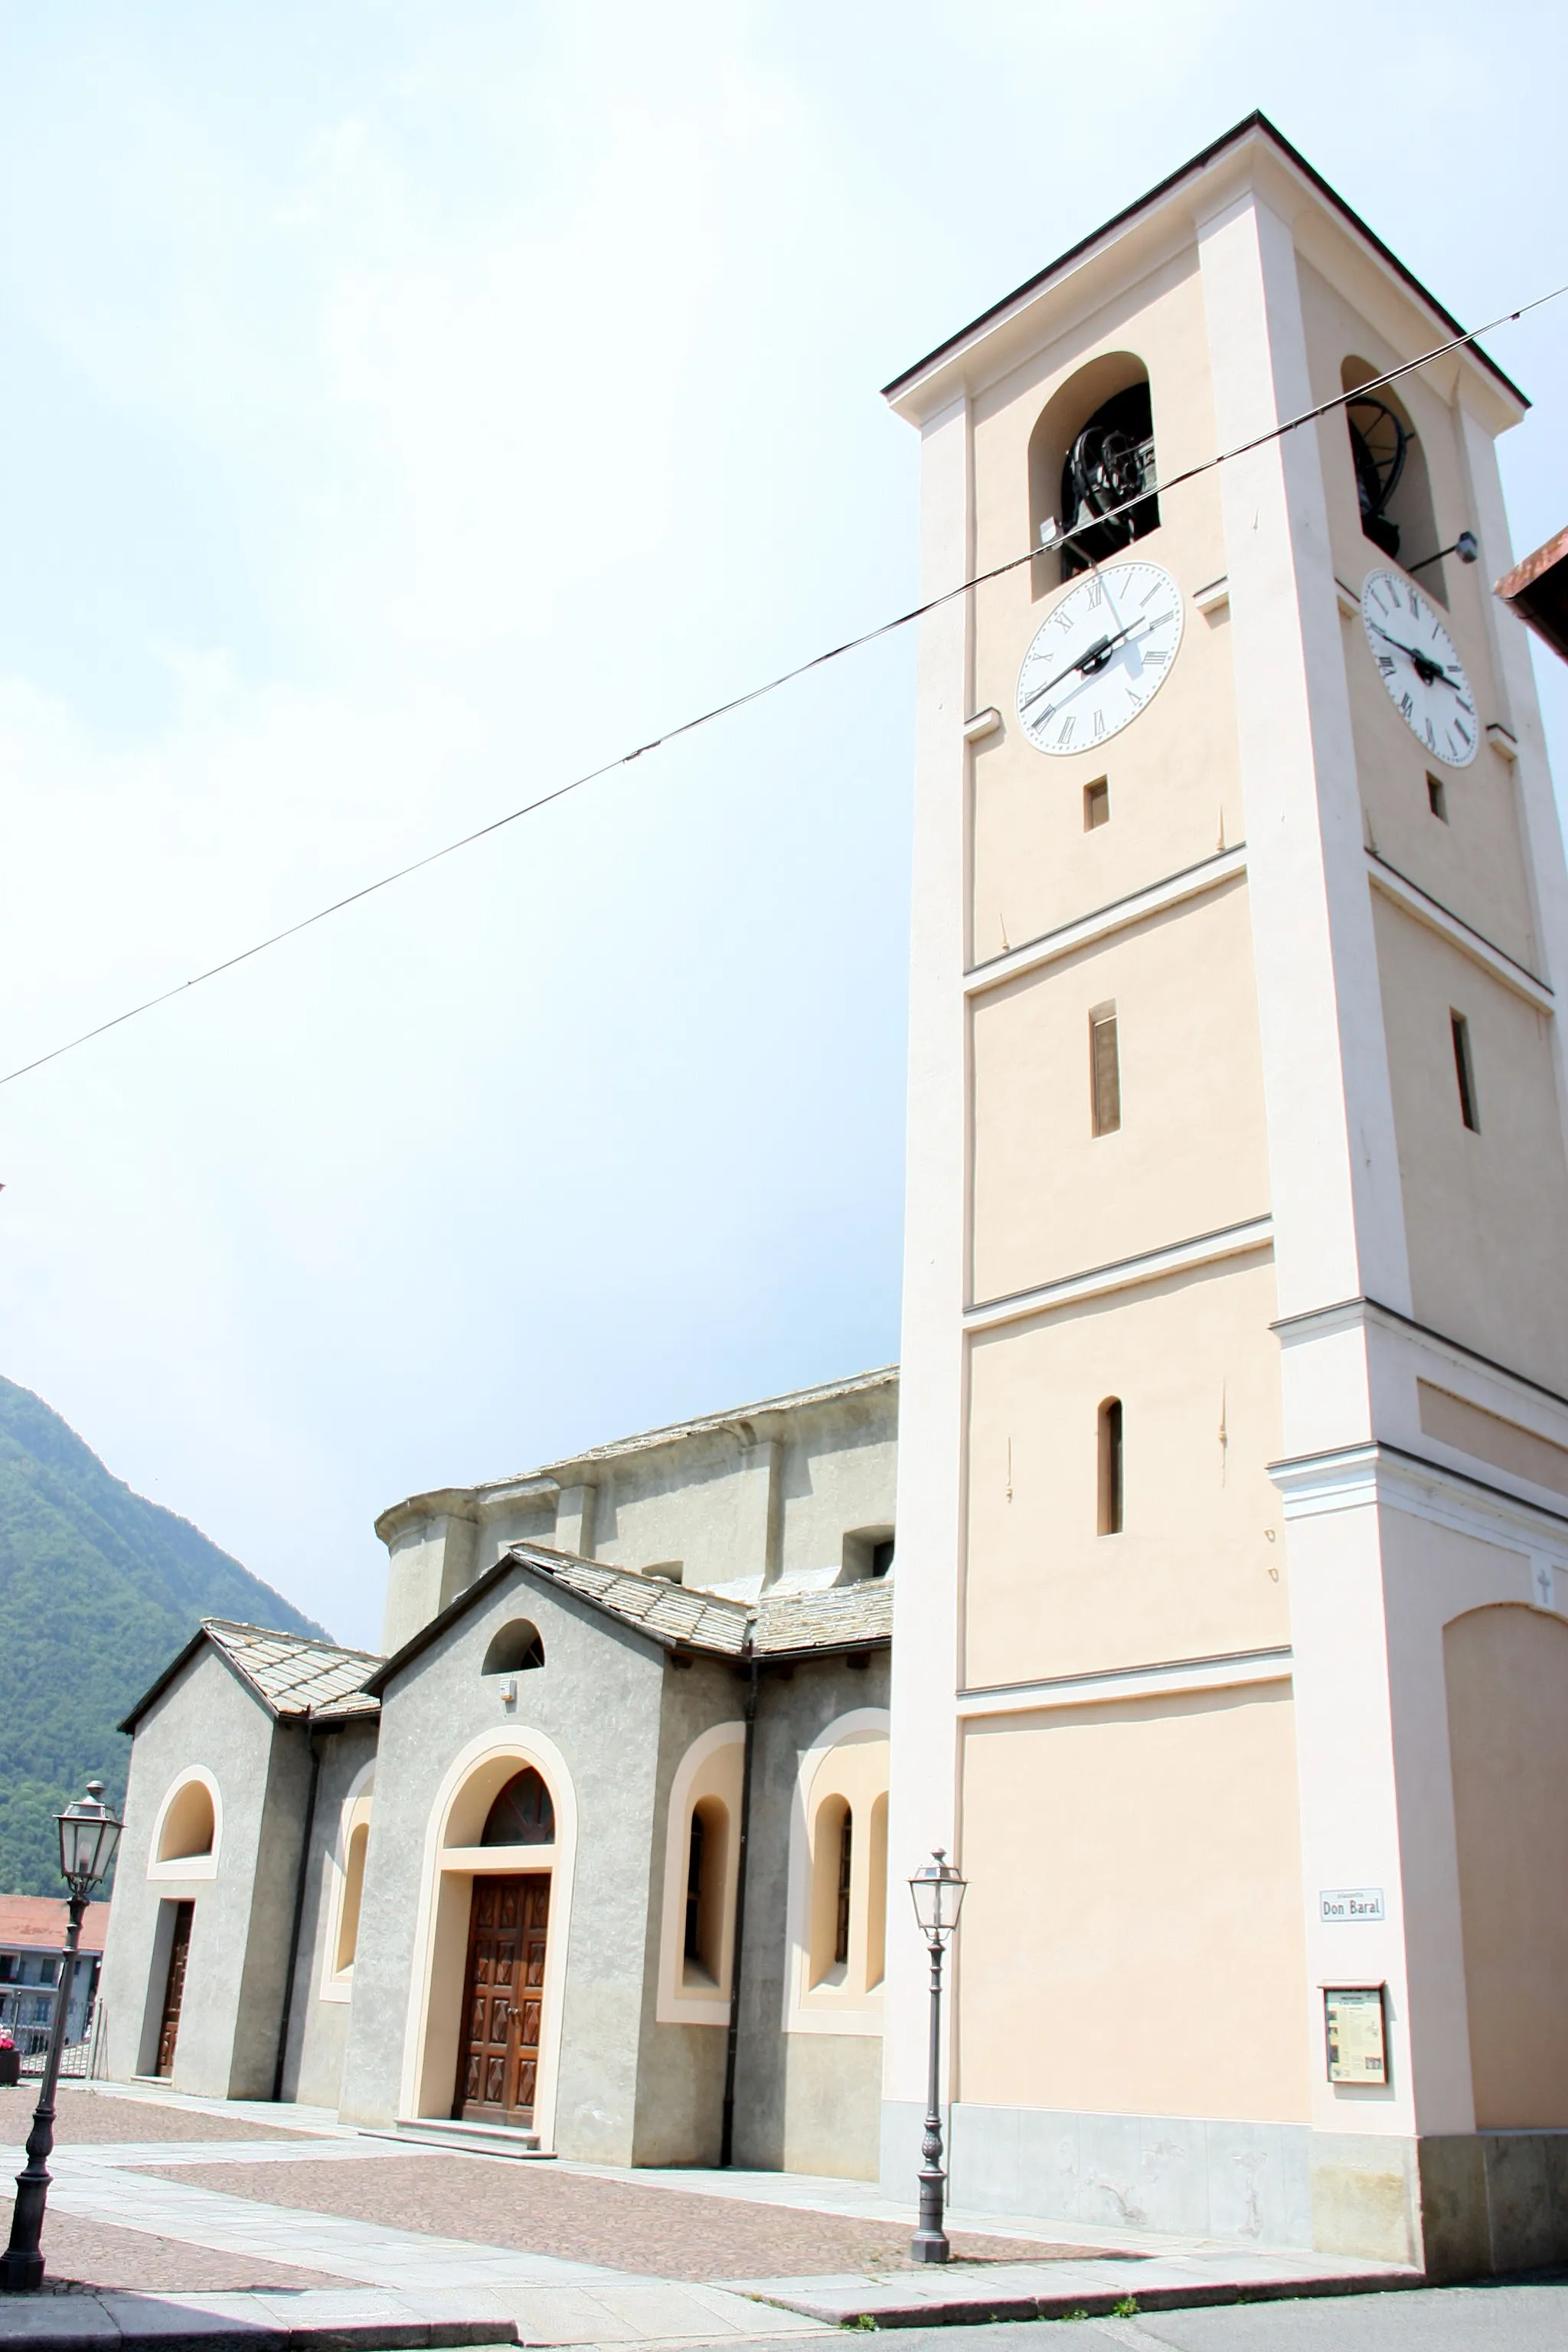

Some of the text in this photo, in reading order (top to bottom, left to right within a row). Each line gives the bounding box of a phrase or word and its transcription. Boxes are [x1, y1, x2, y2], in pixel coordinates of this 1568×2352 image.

[1054, 610, 1075, 635] XI
[1323, 1899, 1380, 1916] Don Baral
